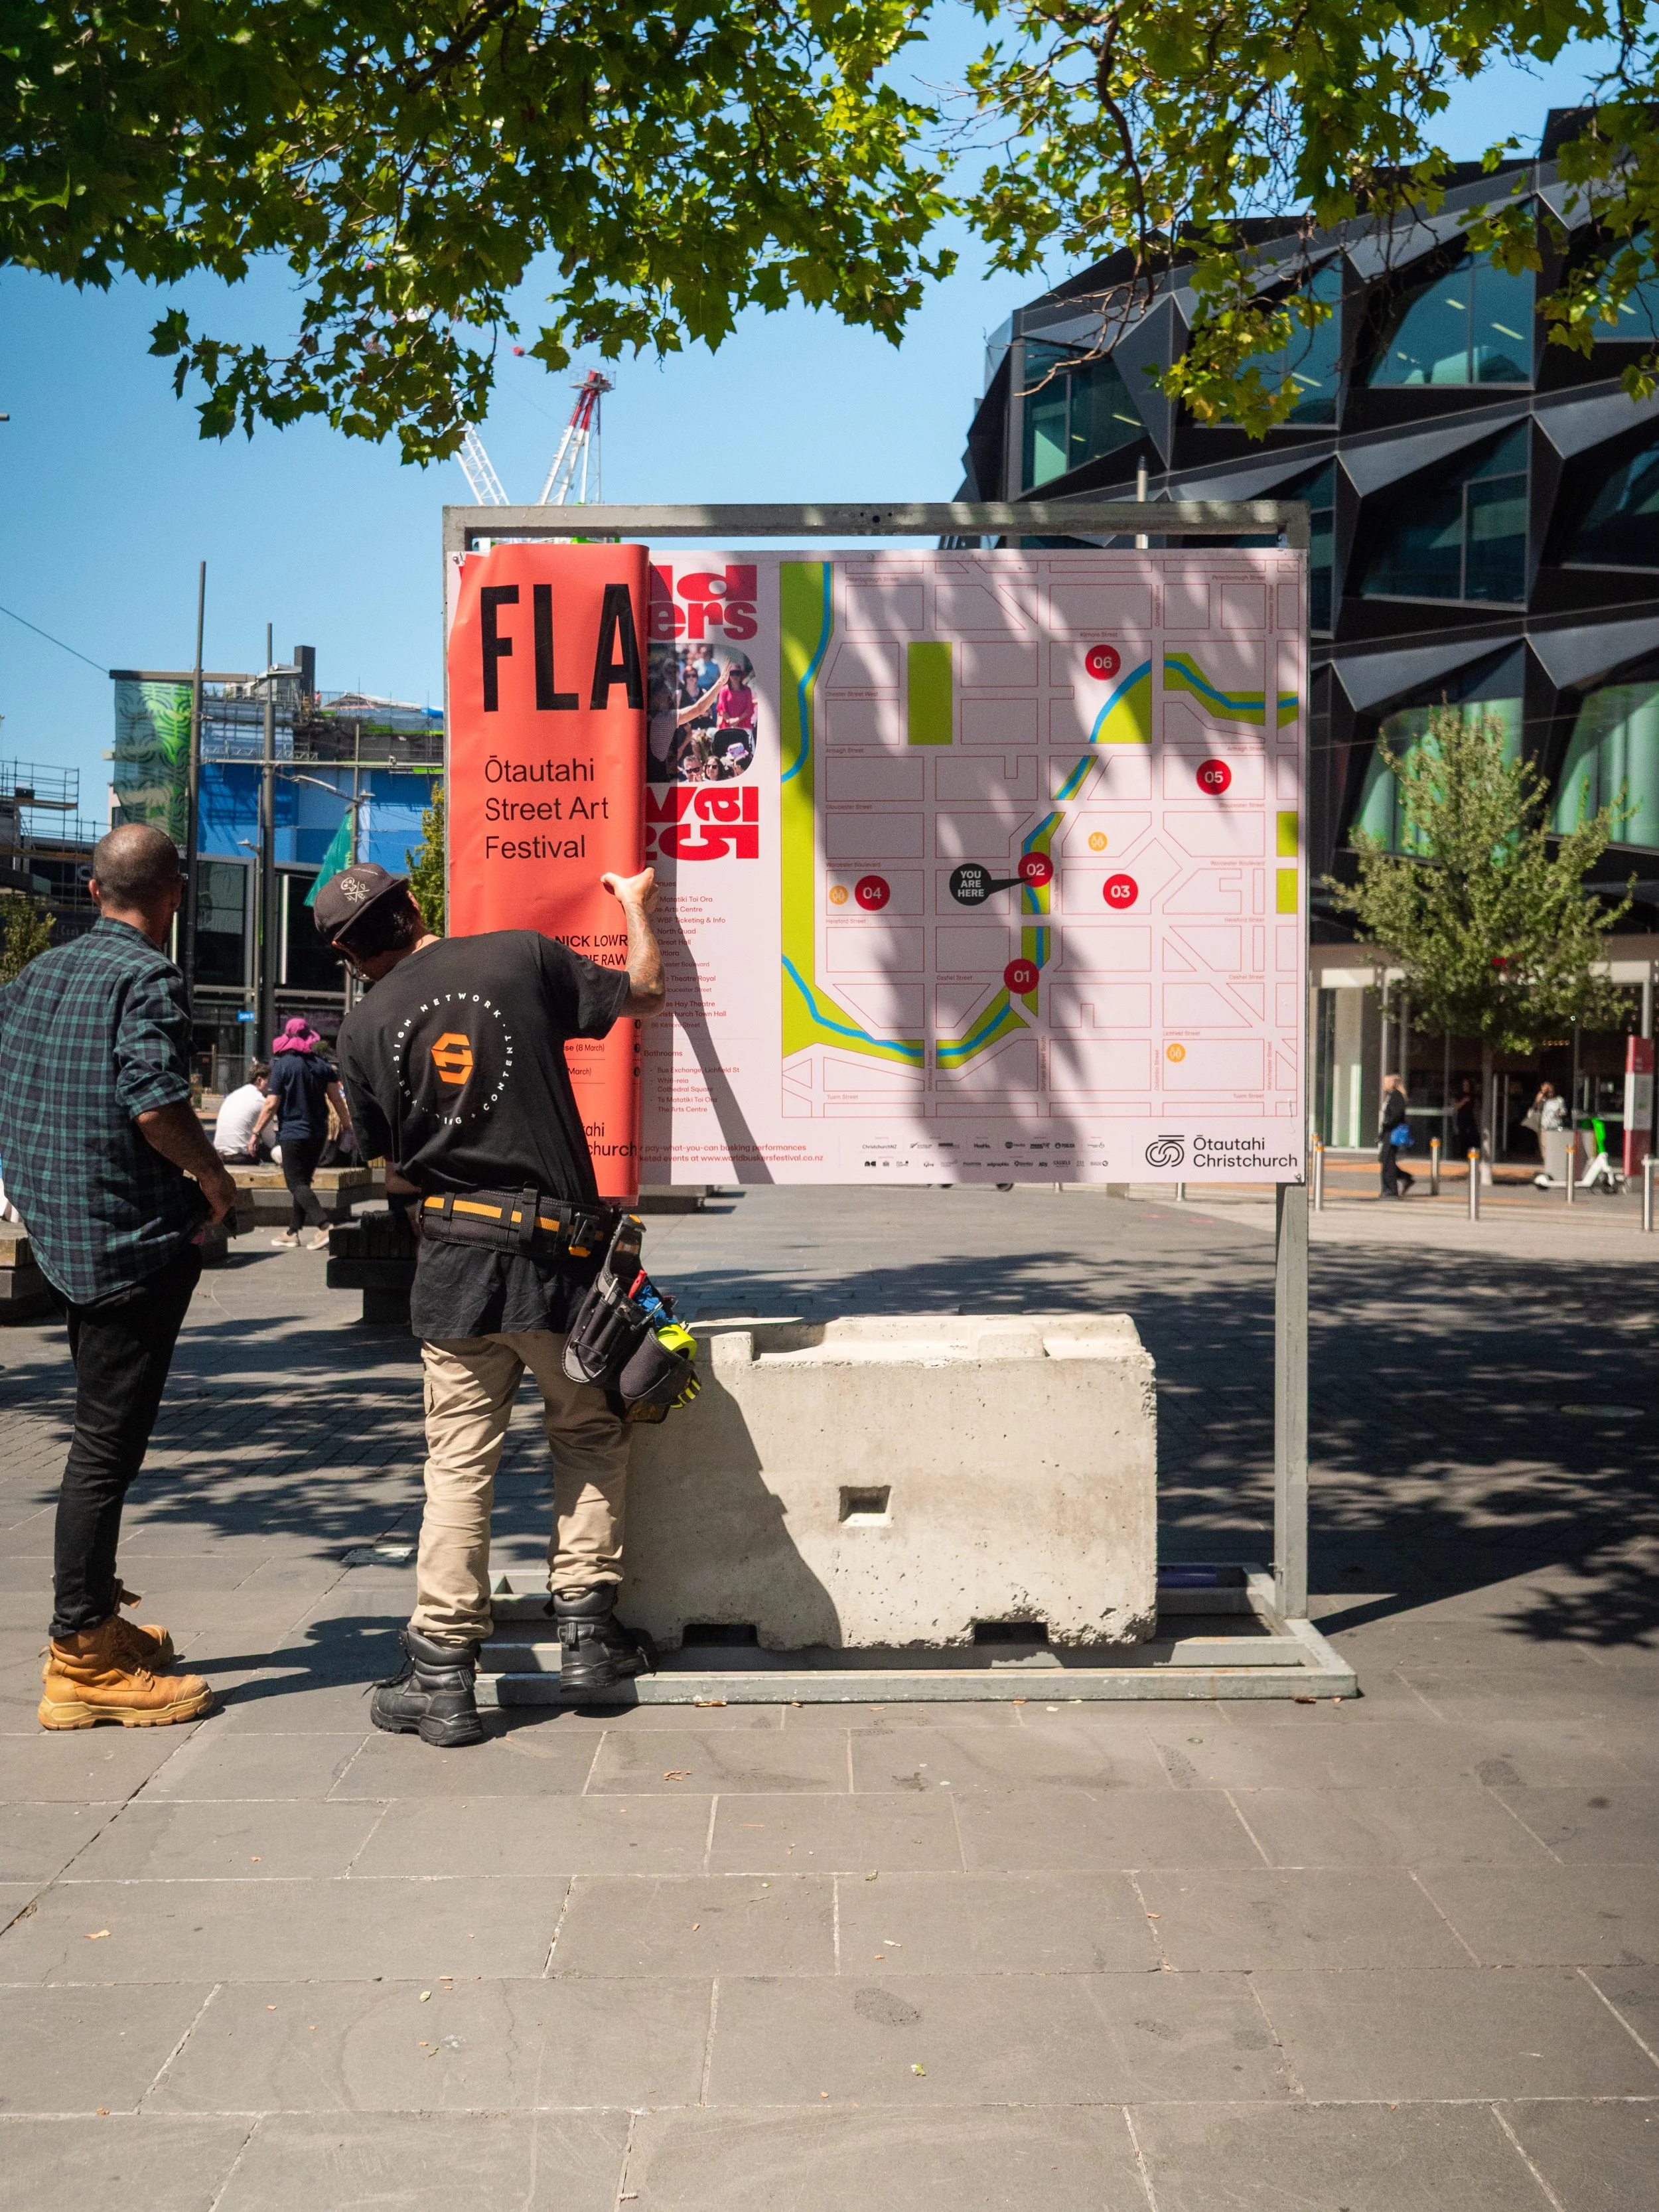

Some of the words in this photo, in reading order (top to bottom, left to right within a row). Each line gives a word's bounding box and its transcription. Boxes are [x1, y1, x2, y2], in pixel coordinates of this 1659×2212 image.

[1093, 656, 1112, 669] 06
[484, 755, 595, 783] Ōtautahi
[1204, 771, 1224, 784] 05
[485, 796, 561, 822] Street
[569, 798, 609, 820] Art
[486, 835, 585, 859] Festival
[960, 870, 981, 879] YOU
[1027, 863, 1045, 876] 02
[960, 879, 981, 888] ARE
[863, 887, 882, 899] 04
[958, 889, 984, 897] HERE
[1111, 885, 1130, 898] 03
[555, 934, 591, 947] NICK
[1013, 970, 1030, 983] 01
[394, 1019, 411, 1062] SIGN
[420, 992, 501, 1018] NETWORK
[575, 1044, 583, 1053] (8
[585, 1043, 605, 1053] March)
[483, 1035, 513, 1111] CONTENT
[645, 1144, 719, 1153] pay-what-you-can
[720, 1143, 751, 1153] busking
[752, 1143, 807, 1153] performances
[1193, 1135, 1265, 1151] Ōtautahi
[1193, 1153, 1298, 1167] Christchurch
